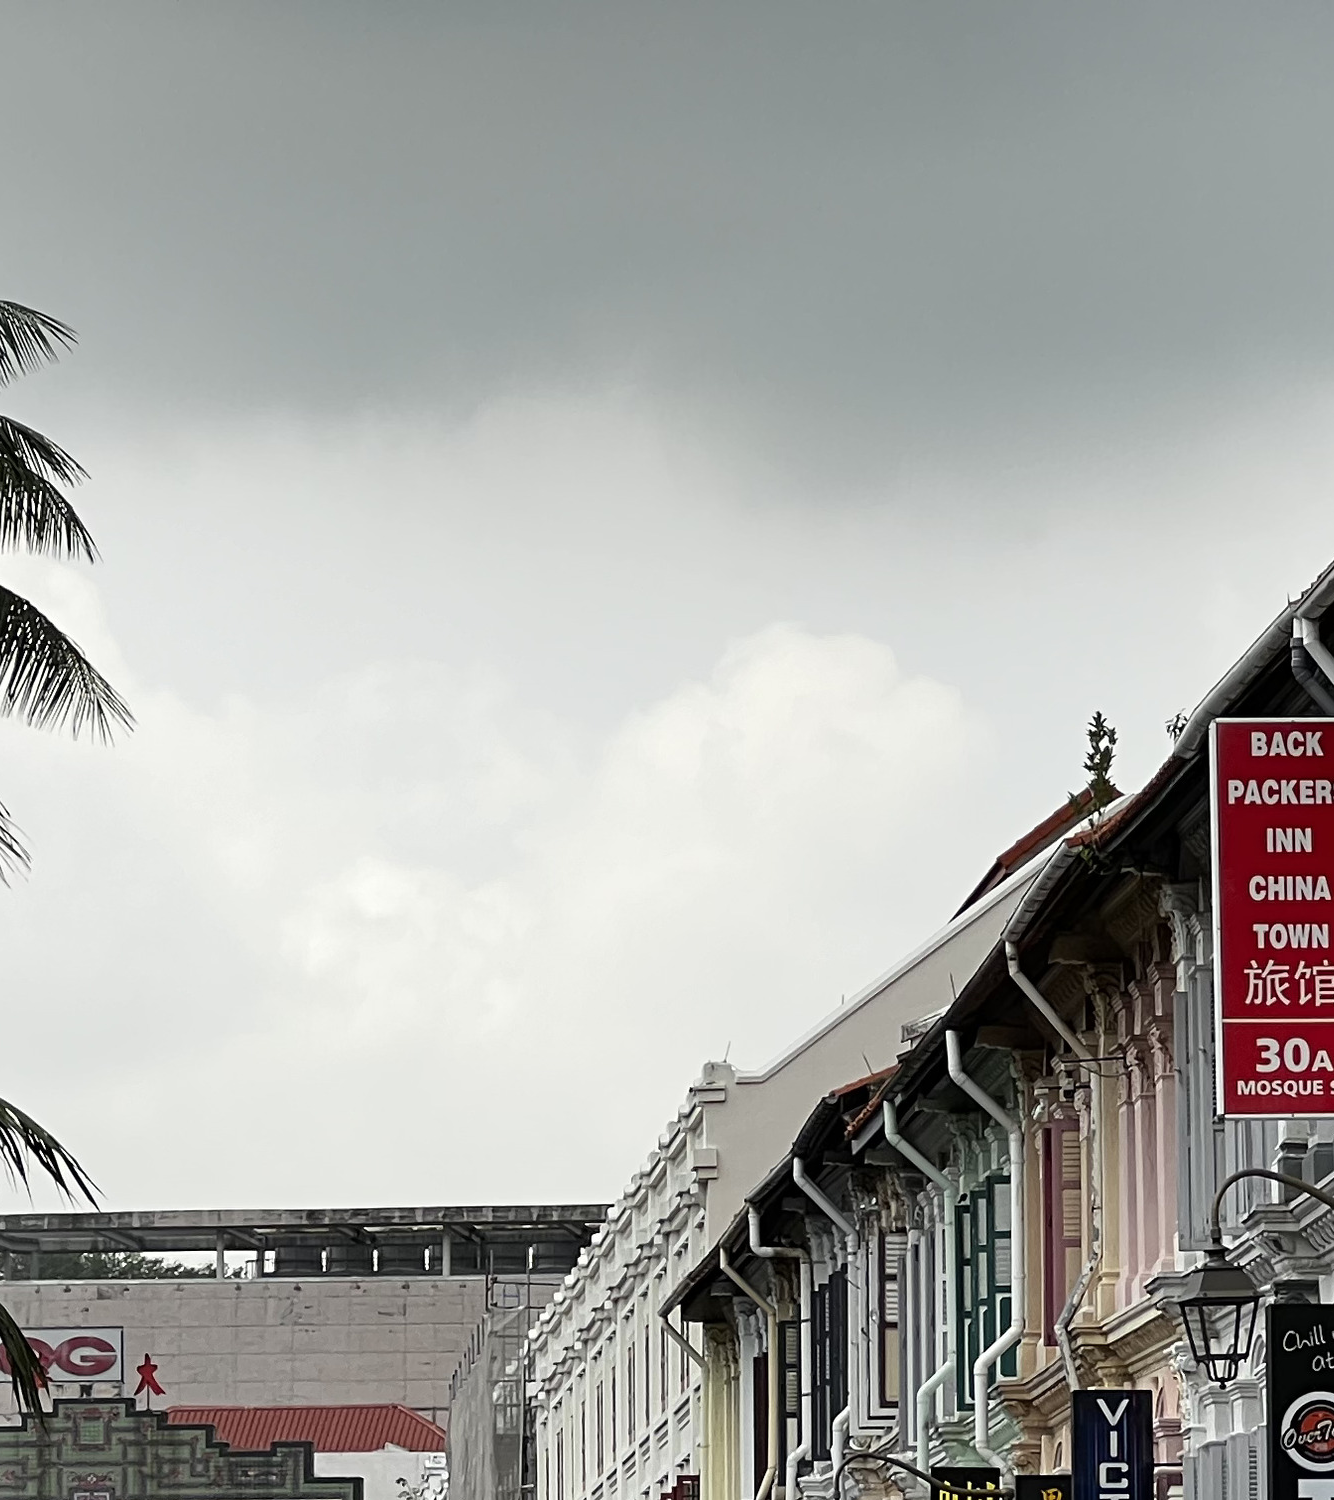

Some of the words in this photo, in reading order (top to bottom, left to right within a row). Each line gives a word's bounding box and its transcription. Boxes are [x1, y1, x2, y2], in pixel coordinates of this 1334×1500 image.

[1250, 731, 1323, 757] BACK
[1267, 828, 1312, 853] INN
[1248, 875, 1332, 901] CHINA
[1253, 923, 1330, 949] TOWN
[1255, 1037, 1334, 1073] 30A
[1237, 1079, 1325, 1097] MOSQUE
[1283, 1324, 1326, 1351] Chill
